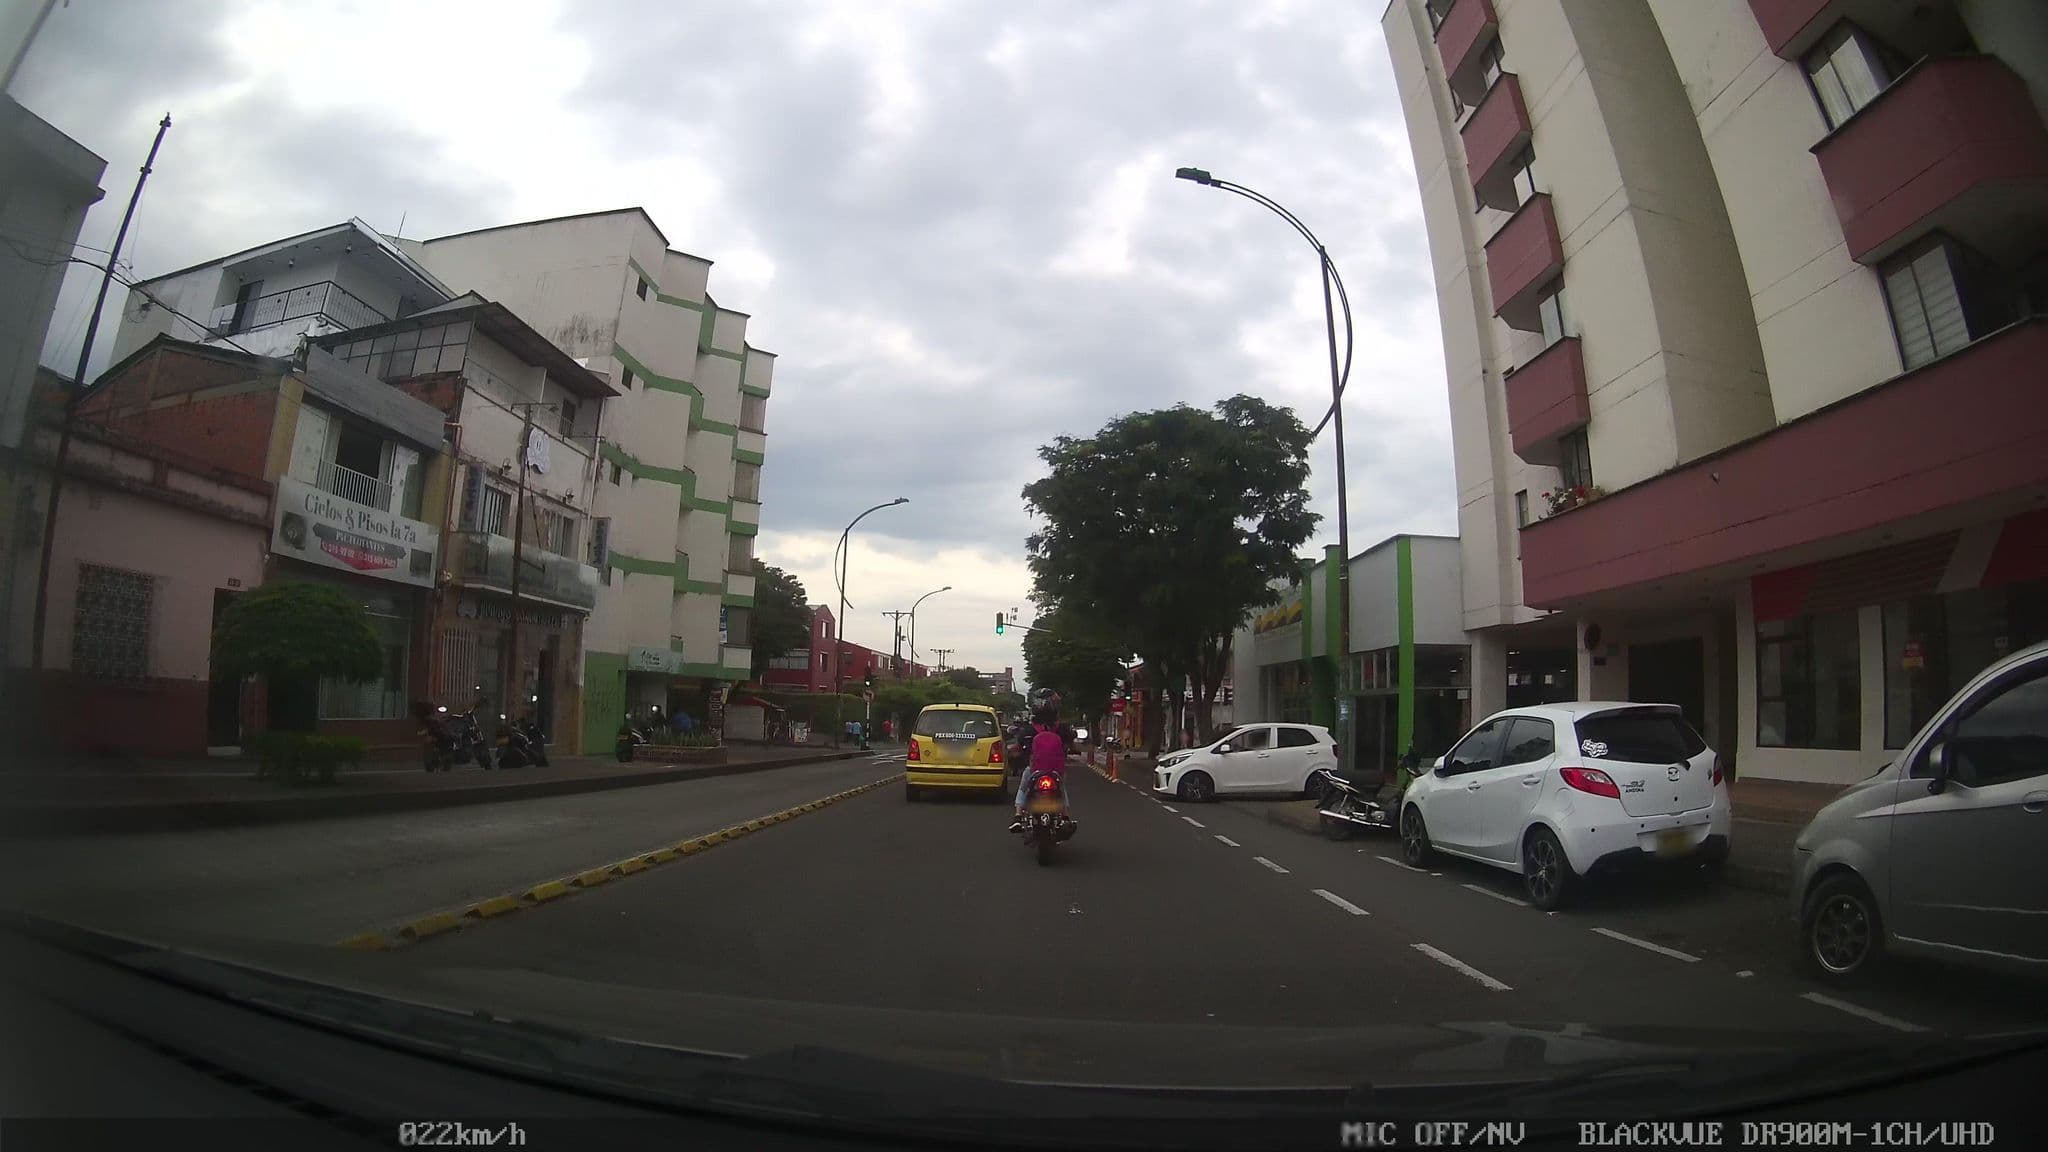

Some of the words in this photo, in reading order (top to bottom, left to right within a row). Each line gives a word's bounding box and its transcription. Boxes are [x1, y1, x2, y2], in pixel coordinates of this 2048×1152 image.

[345, 508, 355, 531] &
[358, 511, 388, 535] Pisos
[390, 520, 400, 540] la
[403, 525, 416, 543] 7a
